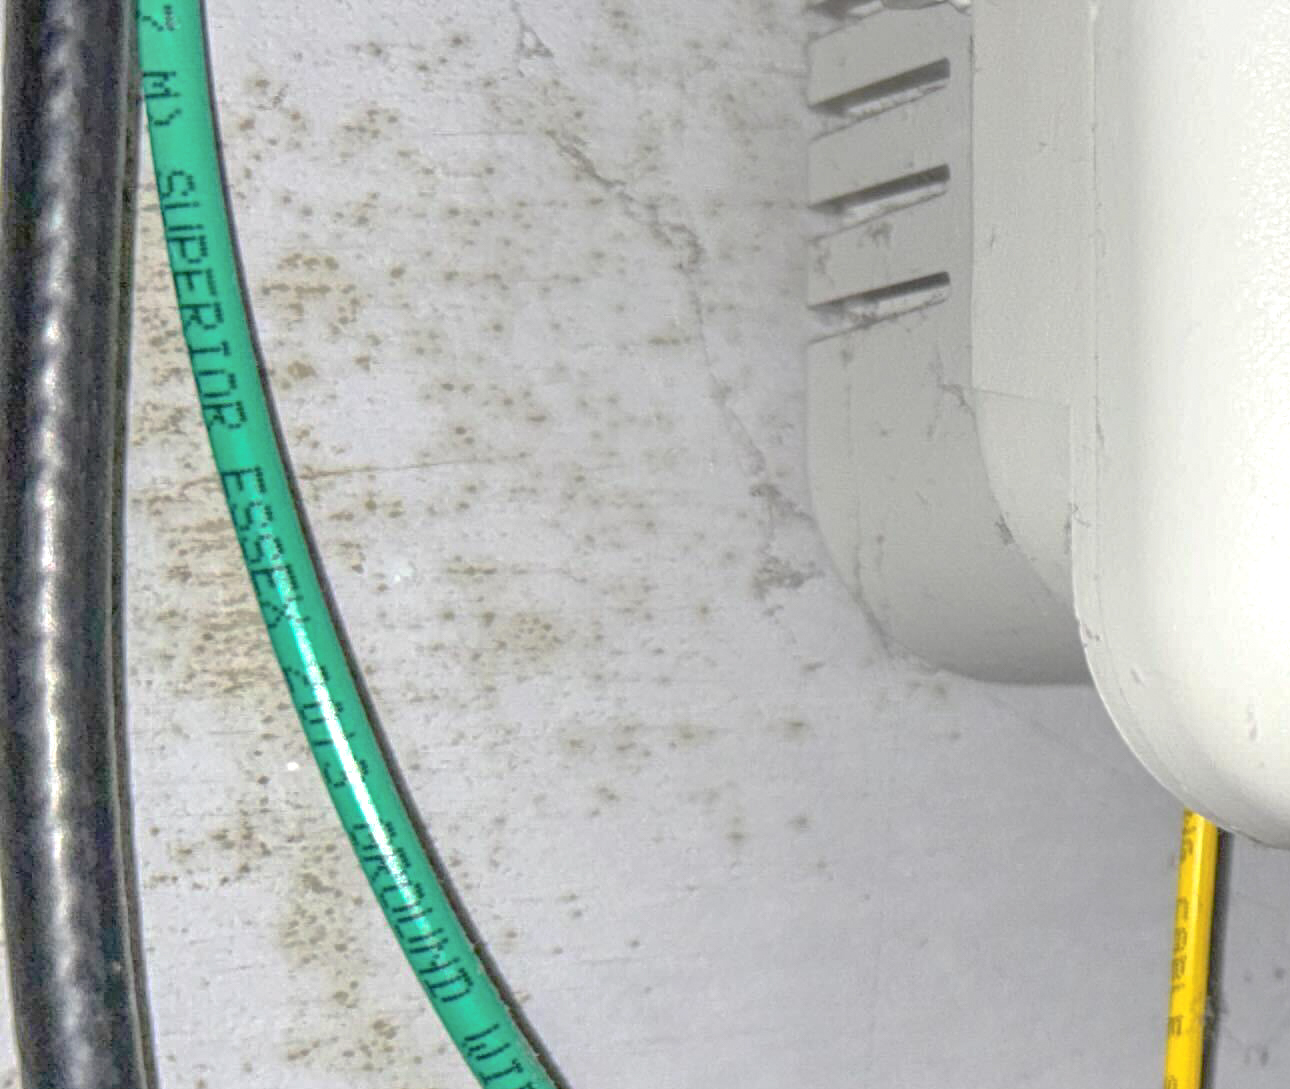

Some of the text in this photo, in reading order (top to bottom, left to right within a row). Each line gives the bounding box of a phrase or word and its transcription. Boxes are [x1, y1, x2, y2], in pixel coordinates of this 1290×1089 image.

[158, 168, 247, 432] SUPERIOR
[222, 465, 311, 629] ESSEX
[461, 1022, 537, 1089] WI
